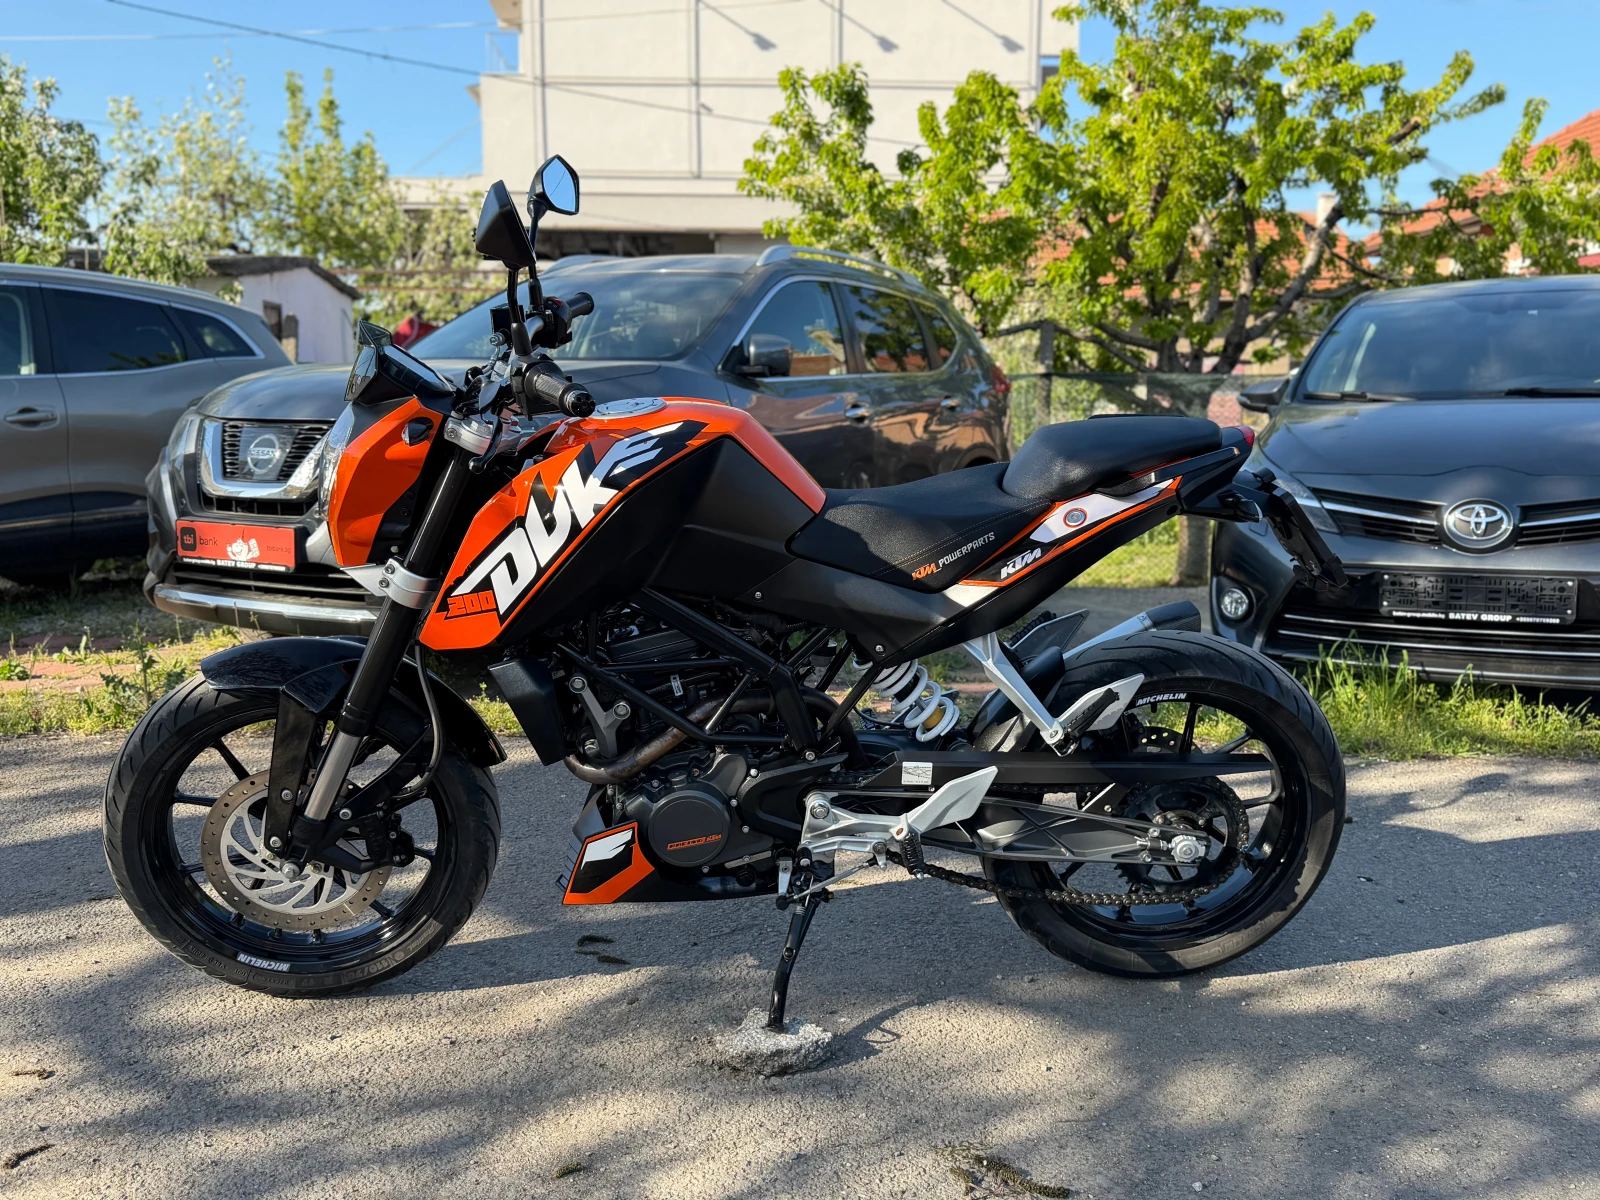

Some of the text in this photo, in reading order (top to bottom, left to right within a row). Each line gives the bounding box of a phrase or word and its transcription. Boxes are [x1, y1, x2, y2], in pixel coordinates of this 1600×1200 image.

[450, 421, 684, 615] DUKE
[183, 534, 195, 545] tbi
[199, 536, 218, 547] bank
[911, 531, 996, 580] KTM POWERPARTS
[1001, 548, 1041, 579] KTM
[447, 589, 497, 615] 200
[1448, 612, 1479, 621] BATEV
[1480, 613, 1513, 623] GROUP
[1137, 693, 1187, 705] MICHELIN
[237, 953, 290, 972] MICHELIN
